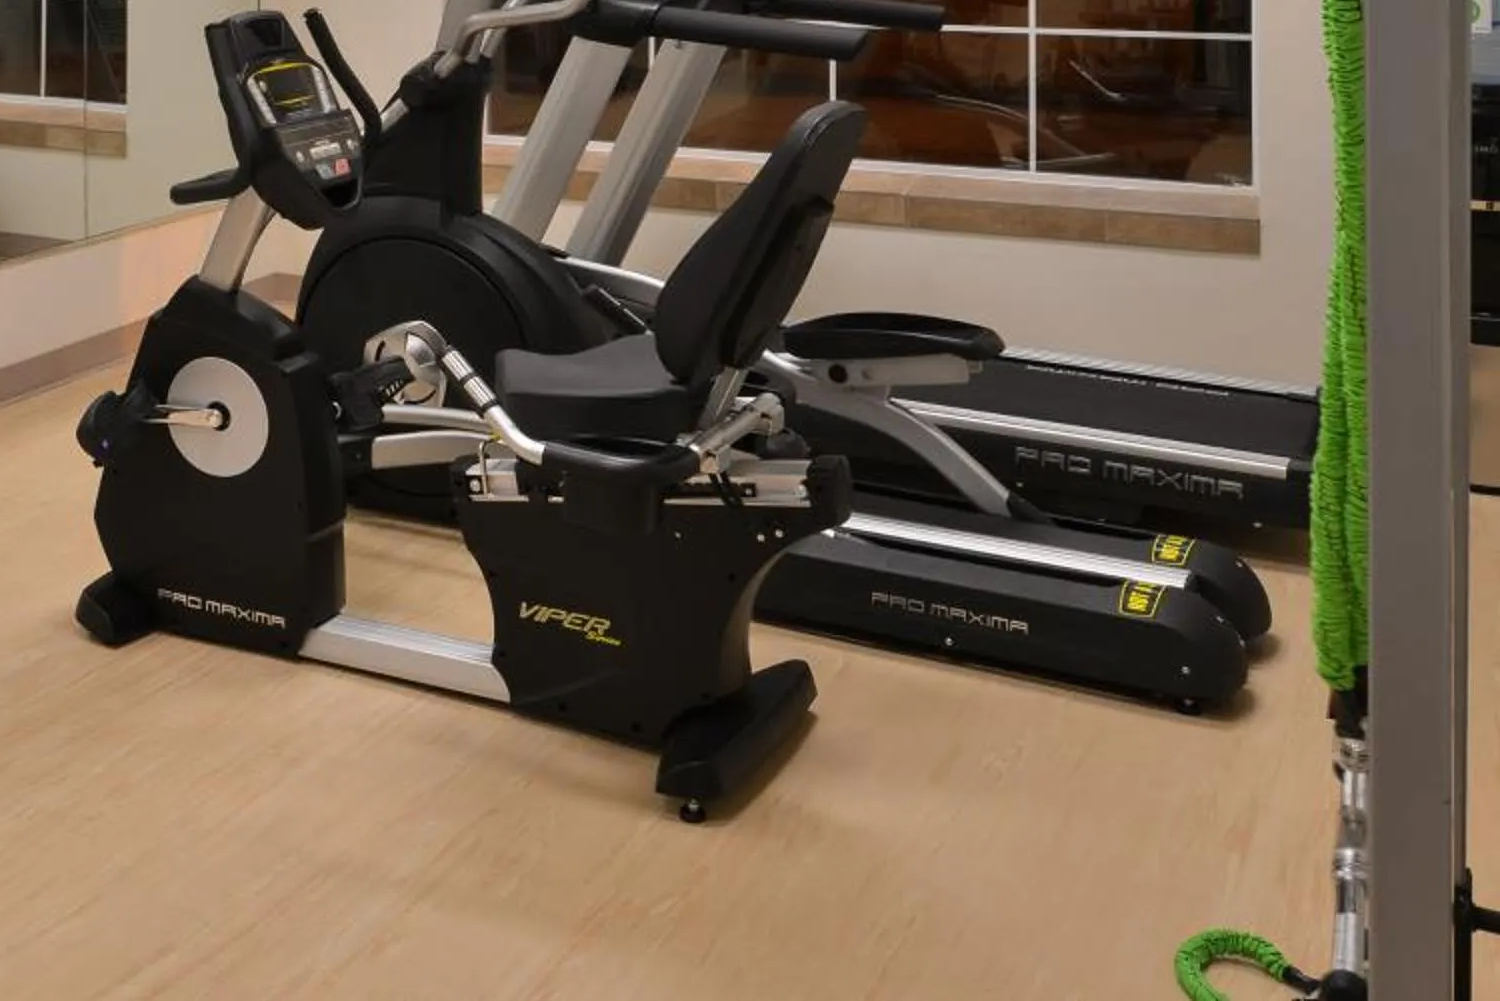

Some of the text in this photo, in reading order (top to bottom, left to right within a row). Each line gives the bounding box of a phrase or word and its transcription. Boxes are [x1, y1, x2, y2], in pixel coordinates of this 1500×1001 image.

[1103, 460, 1244, 500] MAXIMA
[205, 600, 286, 629] MAXIMA
[519, 600, 611, 636] VIPER
[929, 602, 1029, 636] MAXIMA
